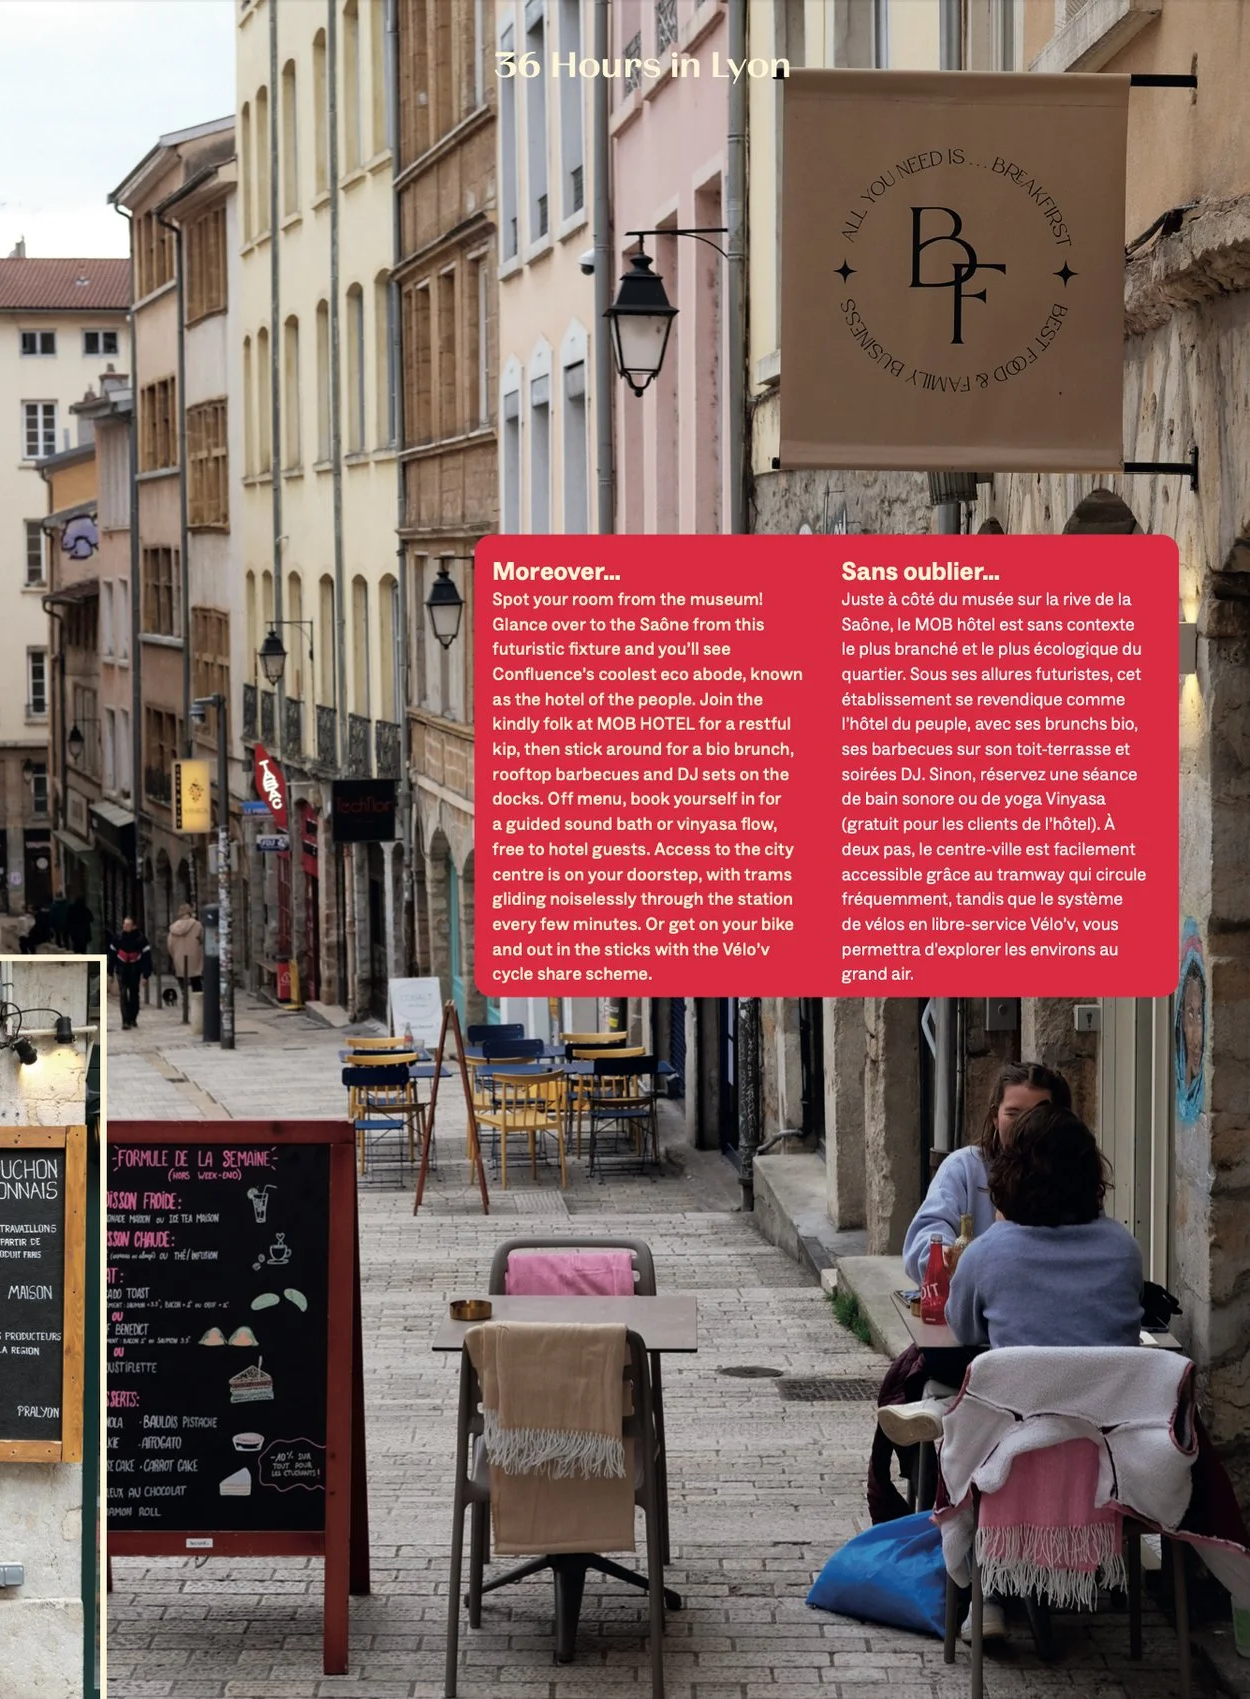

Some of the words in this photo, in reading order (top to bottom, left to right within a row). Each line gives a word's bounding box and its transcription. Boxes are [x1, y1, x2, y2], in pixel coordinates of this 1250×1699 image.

[841, 210, 868, 243] ALL
[861, 171, 896, 204] YOU
[896, 150, 943, 179] NEED
[992, 156, 1073, 247] BREAKFIRST
[1035, 303, 1069, 352] BEST
[840, 298, 906, 378] BUSINESS
[993, 346, 1039, 383] FOOD
[905, 369, 971, 393] FAMILY
[976, 372, 989, 389] &
[259, 760, 283, 810] TABAC
[118, 1149, 169, 1167] FORMULE
[175, 1149, 188, 1167] DE
[198, 1150, 213, 1167] LA
[181, 1214, 193, 1223] TEA
[0, 1224, 57, 1234] TRAVAILLONS
[0, 1238, 27, 1246] PARTIR
[30, 1237, 41, 1246] DE
[23, 1250, 42, 1259] FRAIS
[8, 1285, 53, 1300] MAISON
[126, 1287, 150, 1299] TOAST
[111, 1311, 124, 1322] OU
[5, 1331, 62, 1341] PRODUCTEURS
[115, 1323, 149, 1336] BENEDICT
[11, 1346, 40, 1356] REGION
[113, 1346, 125, 1357] OU
[17, 1405, 60, 1418] PRALYON
[143, 1459, 175, 1472] CARROT
[177, 1459, 198, 1472] CAKE
[128, 1487, 141, 1498] AU
[144, 1486, 187, 1498] CHOCOLAT
[138, 1506, 161, 1517] ROLL
